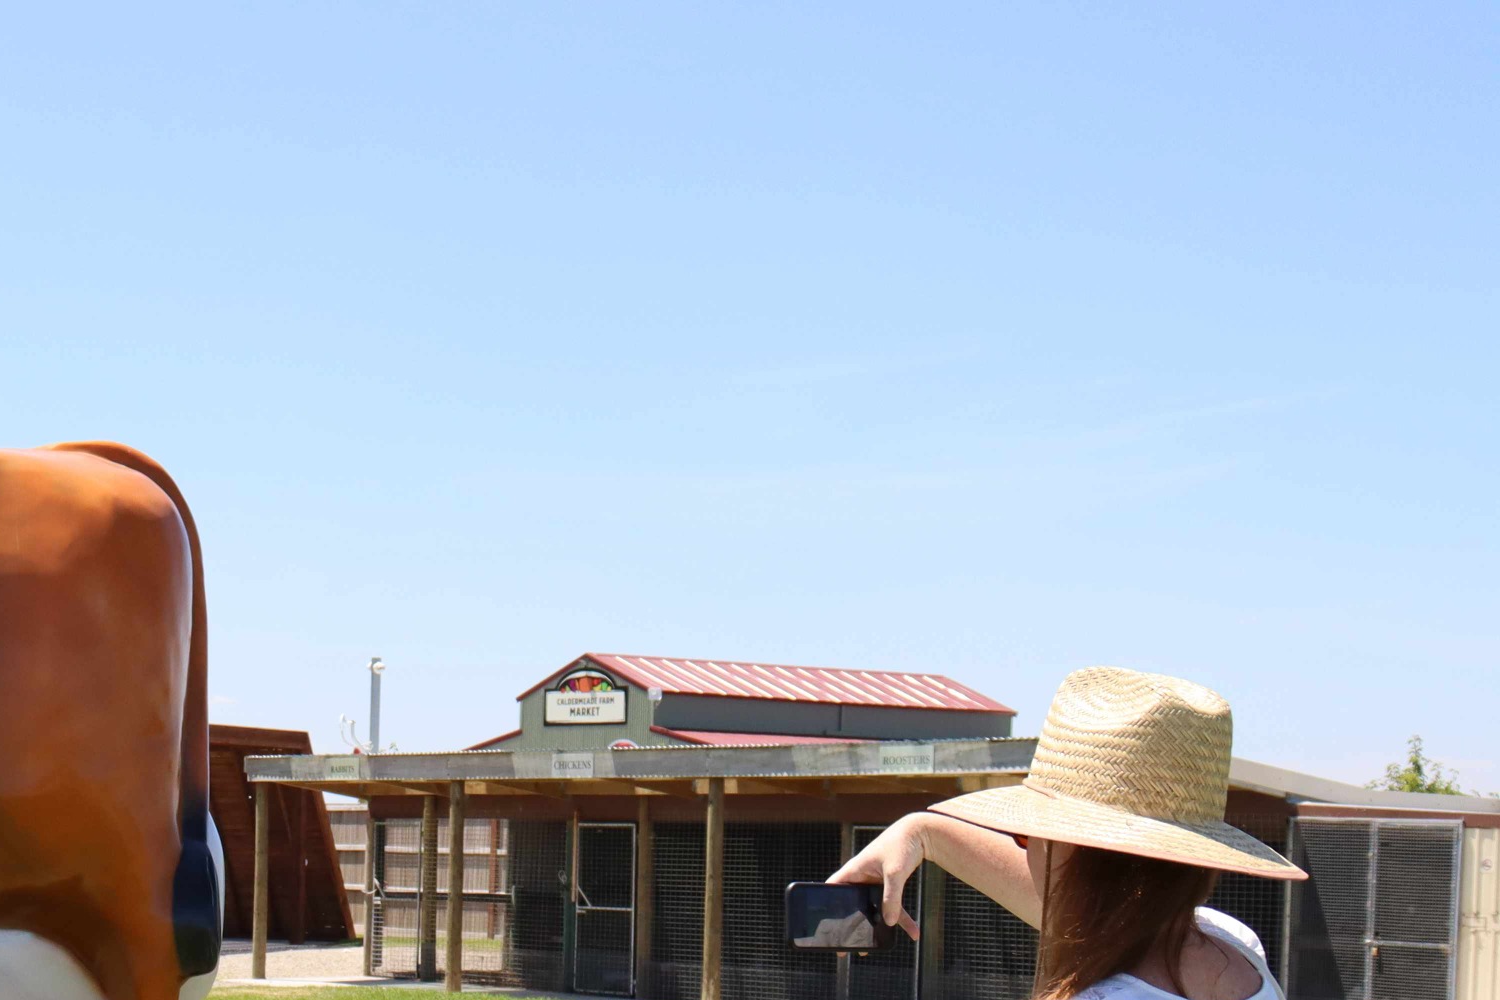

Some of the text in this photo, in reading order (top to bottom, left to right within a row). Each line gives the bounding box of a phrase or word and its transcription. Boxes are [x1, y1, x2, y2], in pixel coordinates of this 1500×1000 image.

[557, 697, 598, 705] CALDERMEADE
[570, 707, 600, 716] MARKET
[883, 755, 930, 765] ROOSTERS
[554, 761, 591, 769] CHICKENS
